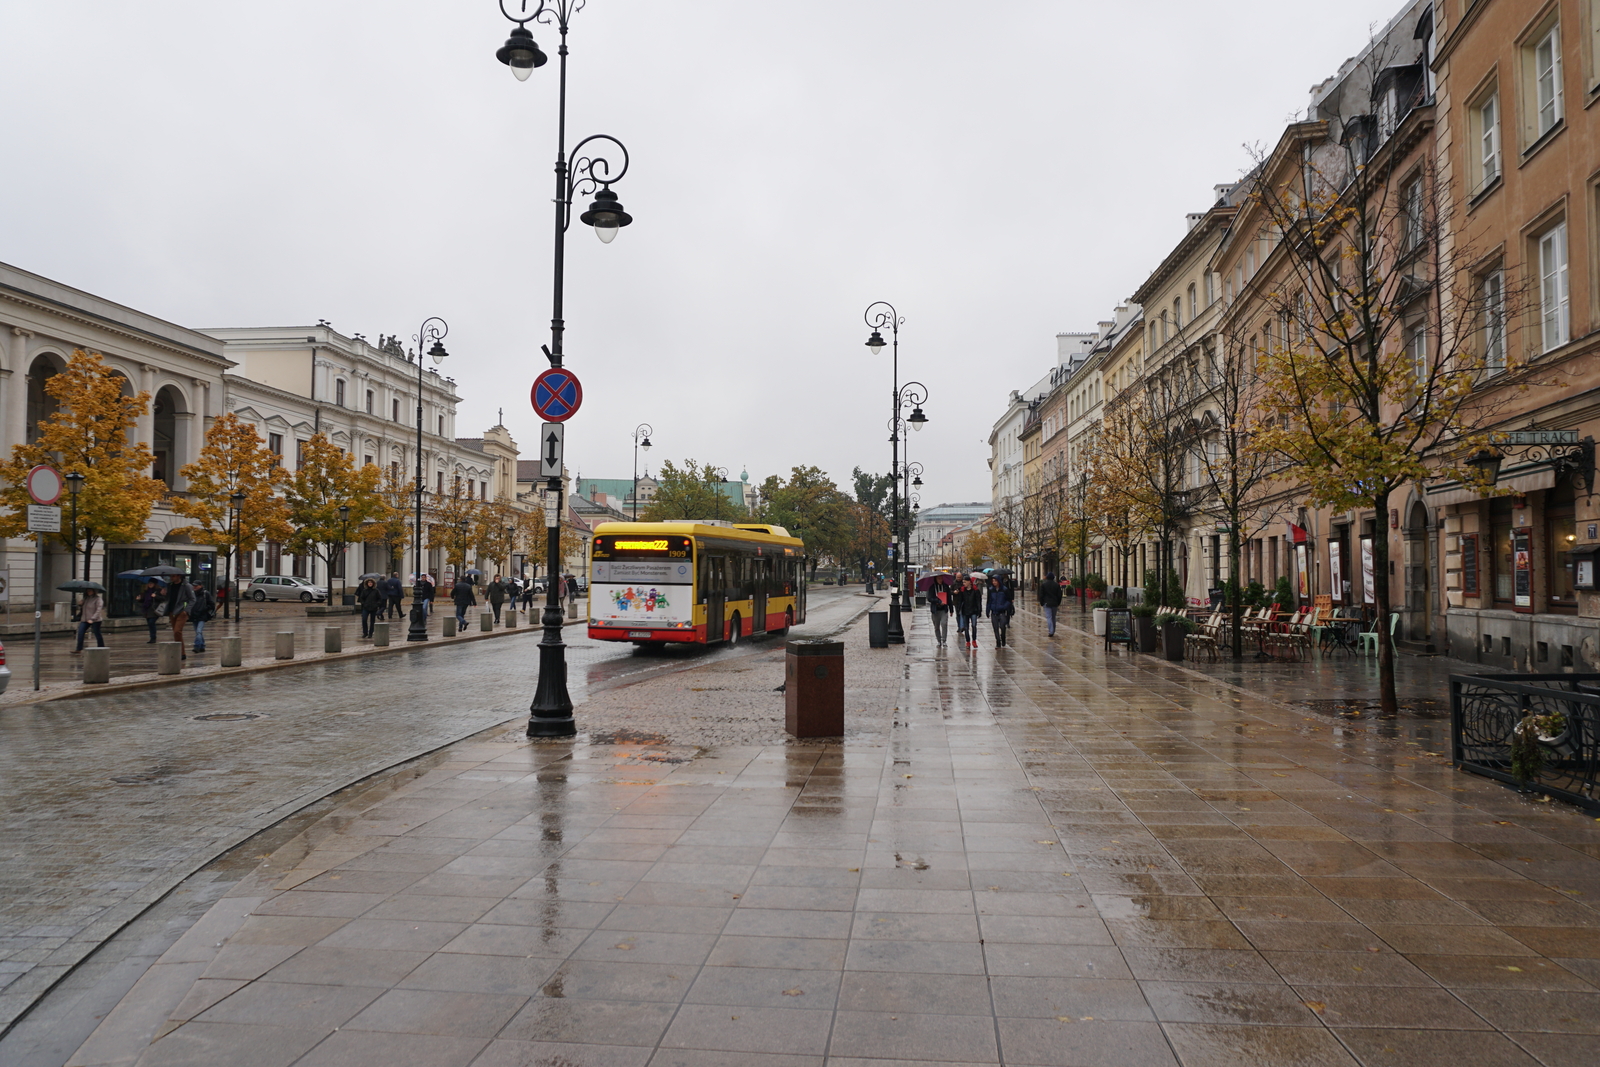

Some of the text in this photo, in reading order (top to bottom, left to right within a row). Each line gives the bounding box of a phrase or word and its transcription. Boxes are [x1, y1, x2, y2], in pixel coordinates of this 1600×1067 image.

[1489, 431, 1577, 443] CFE TRAKT
[654, 540, 668, 551] 222
